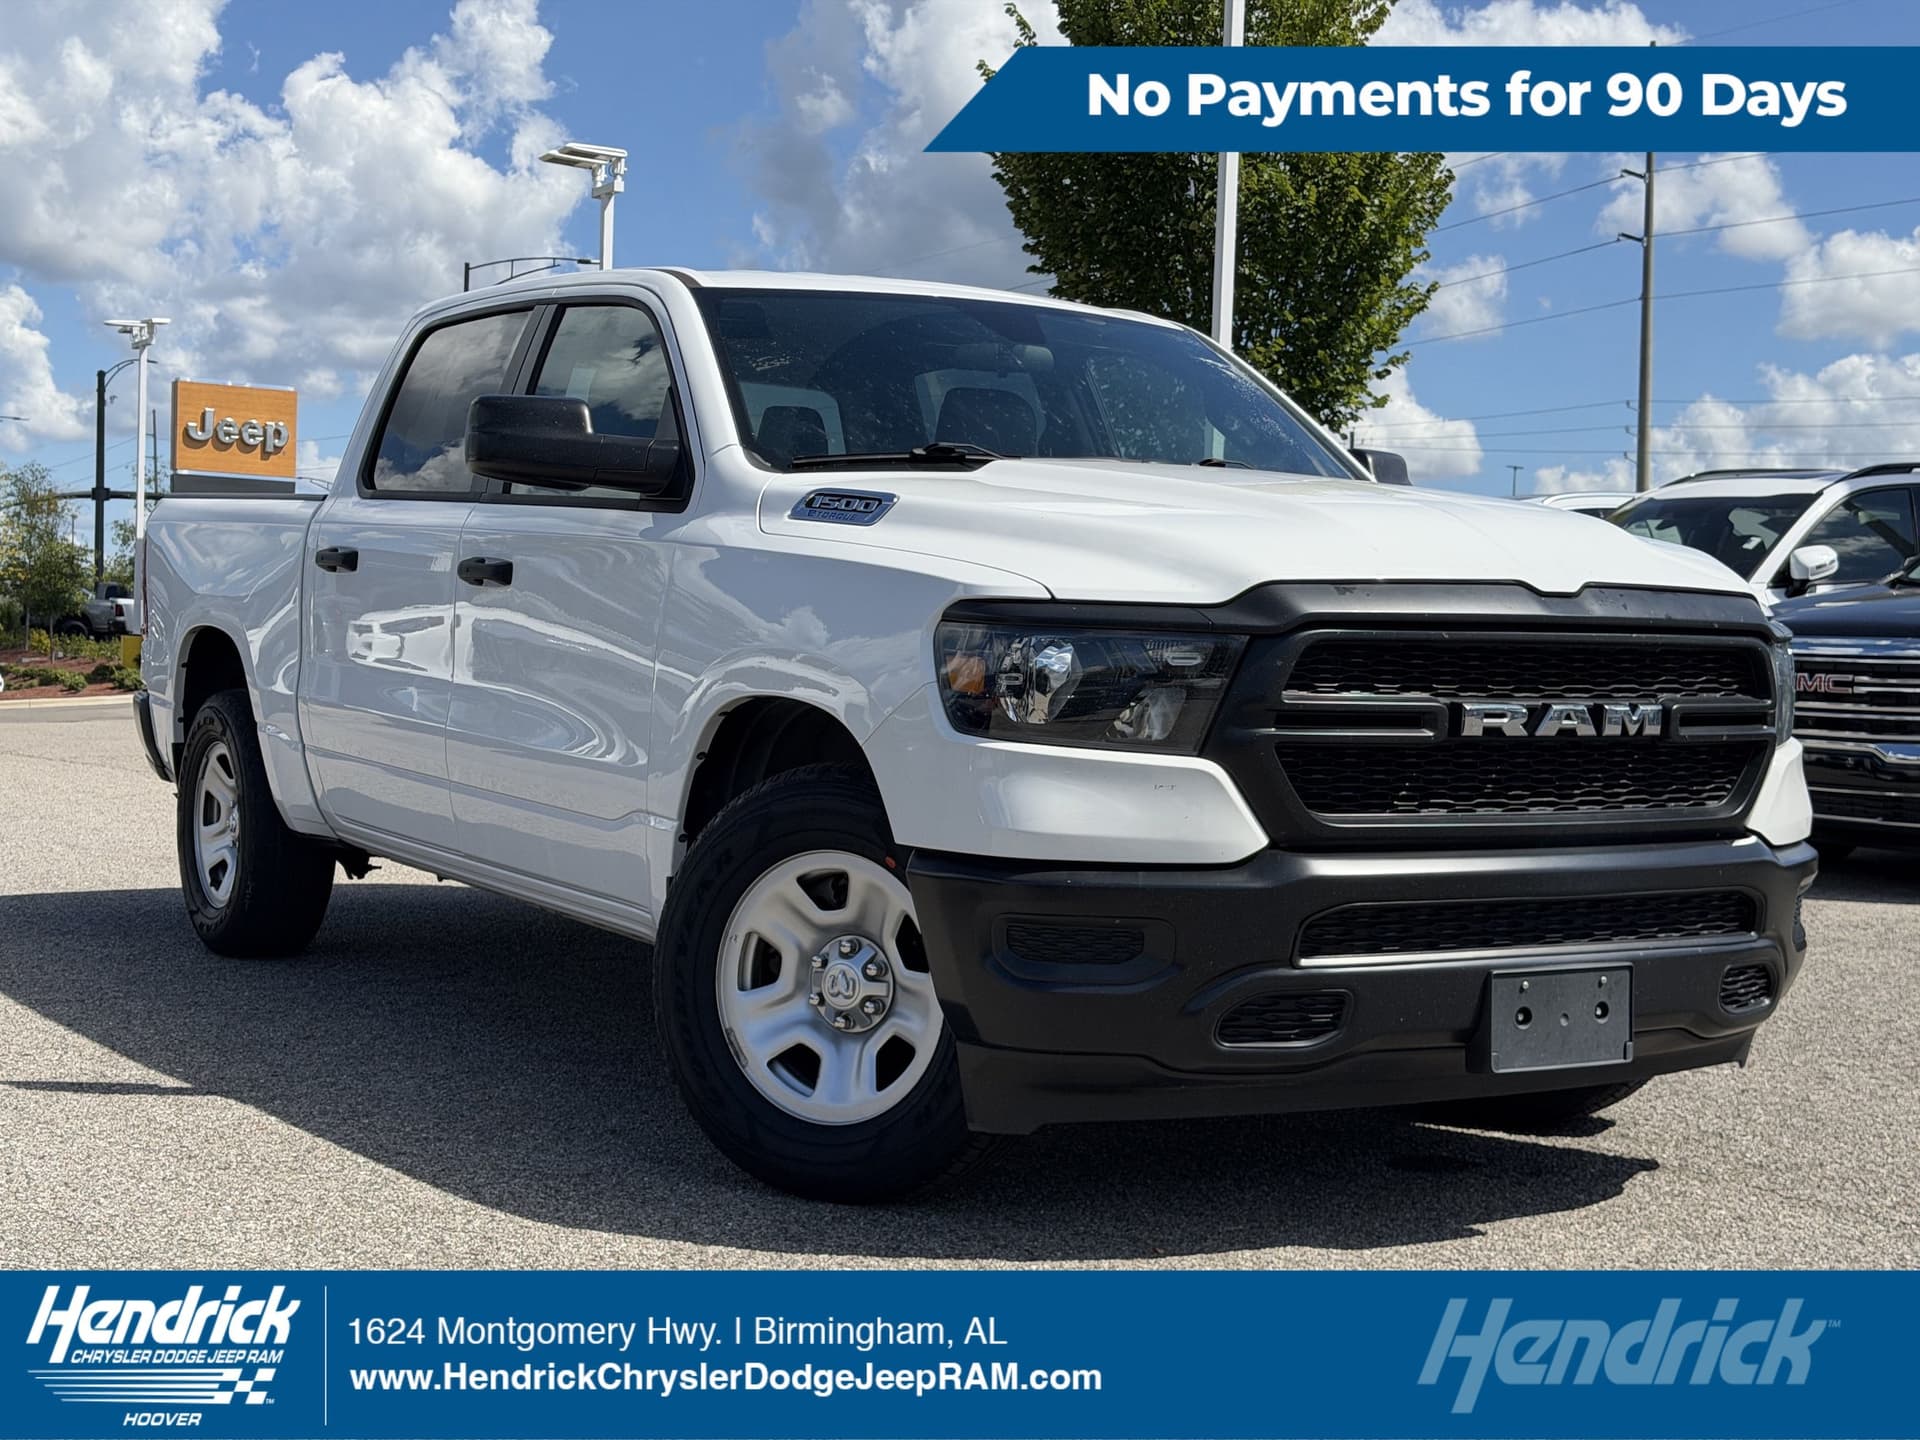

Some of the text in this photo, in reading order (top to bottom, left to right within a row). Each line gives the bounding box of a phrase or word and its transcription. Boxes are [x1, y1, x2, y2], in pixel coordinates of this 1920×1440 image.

[186, 407, 289, 453] Jeep
[811, 494, 880, 513] 1500
[1796, 672, 1853, 694] MC
[1460, 702, 1663, 736] RAM
